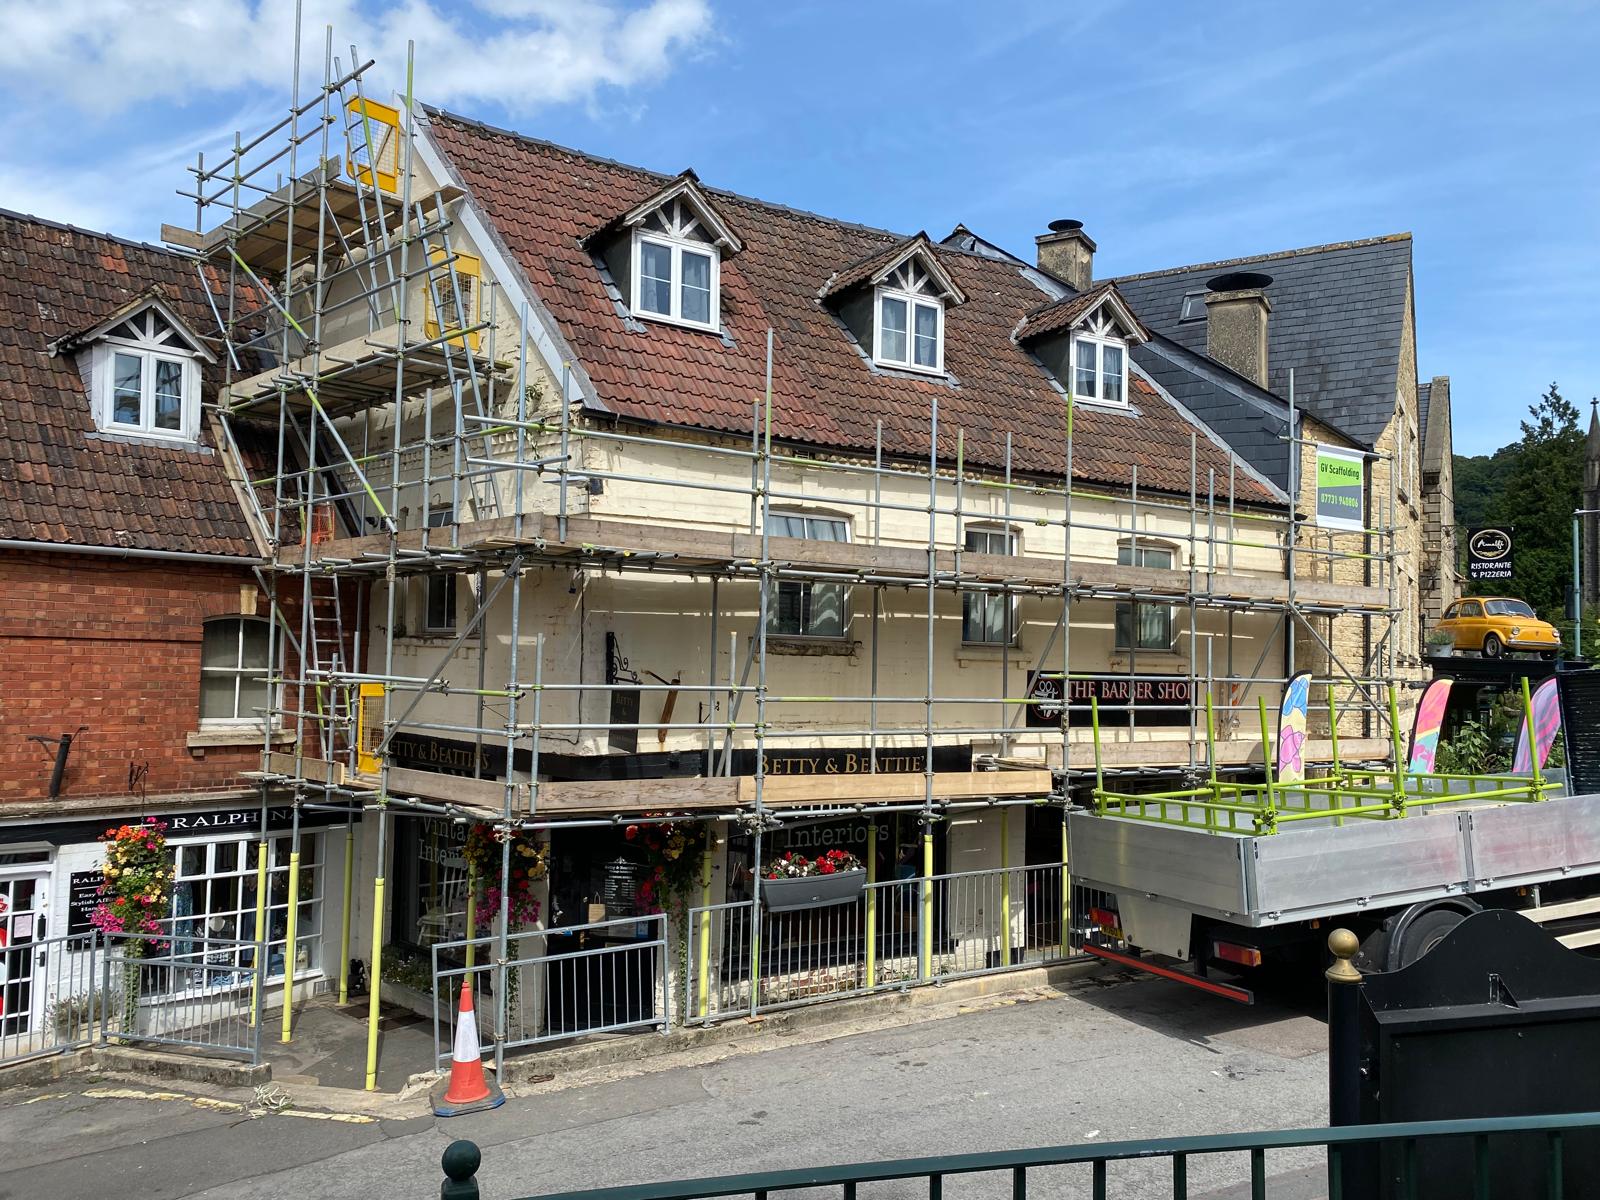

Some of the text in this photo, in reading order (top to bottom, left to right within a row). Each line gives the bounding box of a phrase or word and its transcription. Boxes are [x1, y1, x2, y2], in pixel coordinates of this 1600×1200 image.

[1320, 463, 1360, 480] GV Scaffolding
[1471, 562, 1512, 570] RISTORANTE
[1480, 570, 1512, 578] PIZZERIA
[1068, 680, 1096, 698] THE
[389, 740, 417, 758] ETTY
[825, 757, 839, 774] &
[784, 823, 889, 848] Interios
